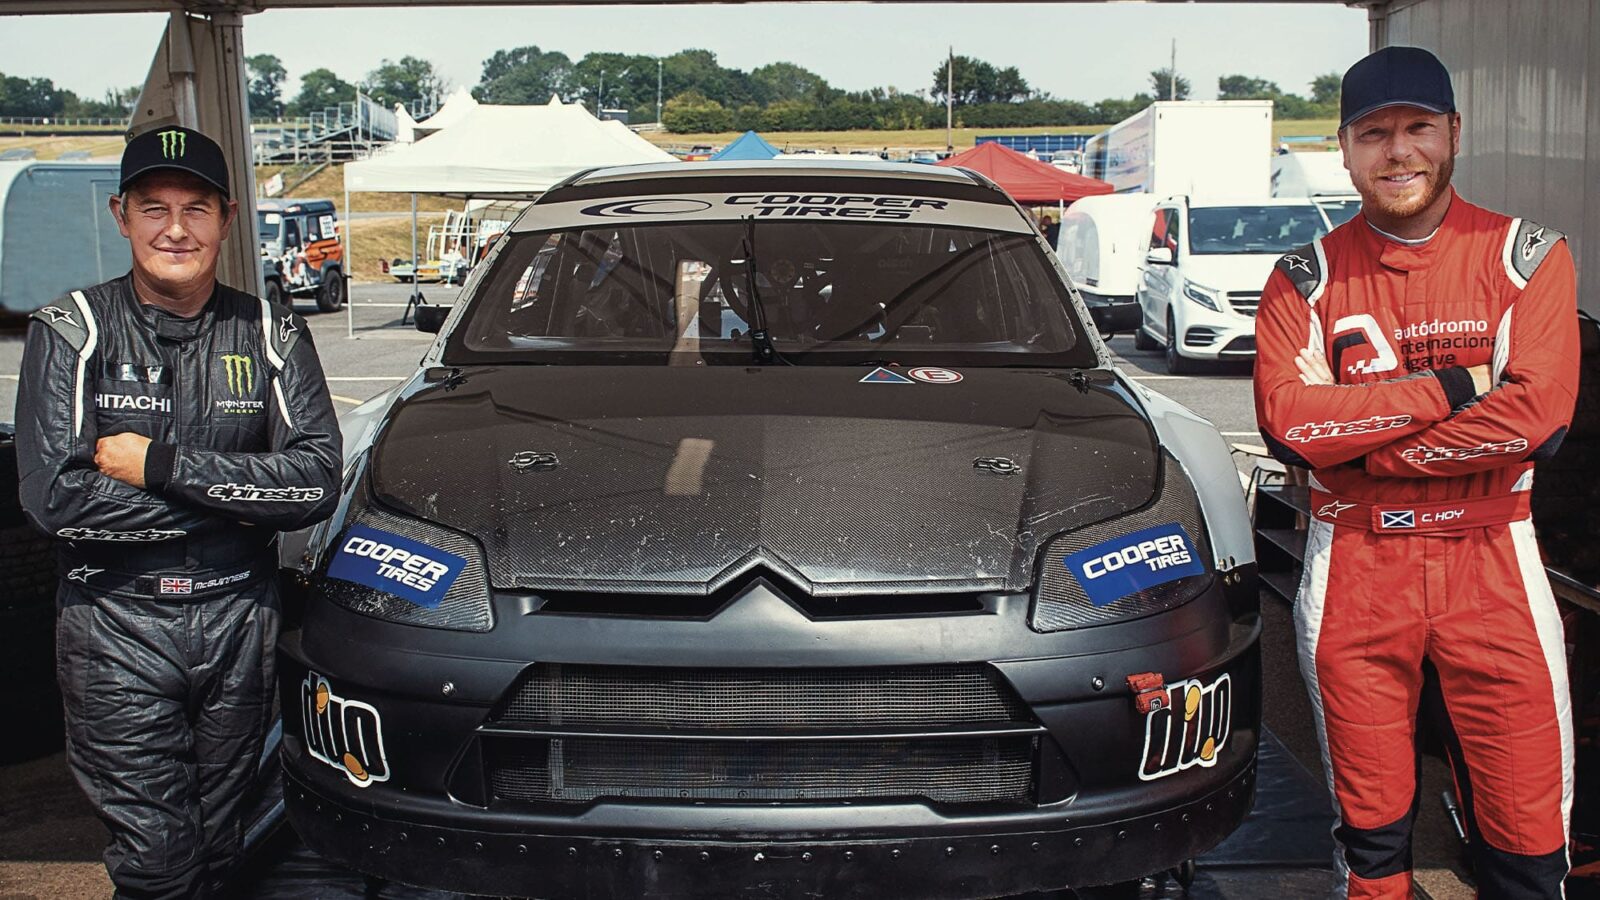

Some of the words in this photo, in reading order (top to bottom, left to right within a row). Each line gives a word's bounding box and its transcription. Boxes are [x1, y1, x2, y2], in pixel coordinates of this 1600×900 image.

[723, 194, 949, 210] COOPER
[753, 206, 916, 220] TIRES
[1394, 319, 1488, 340] autódromo
[94, 392, 171, 413] HITACHI
[216, 399, 264, 409] MONSTER
[1285, 414, 1412, 443] alpinestars
[1401, 438, 1528, 464] alpinestars
[207, 483, 324, 501] alpinestars
[1434, 509, 1465, 522] HOY
[57, 528, 187, 541] alpinestars
[343, 536, 449, 581] COOPER
[1082, 534, 1187, 579] COOPER
[1144, 550, 1192, 572] TIRES
[376, 562, 436, 592] TIRES
